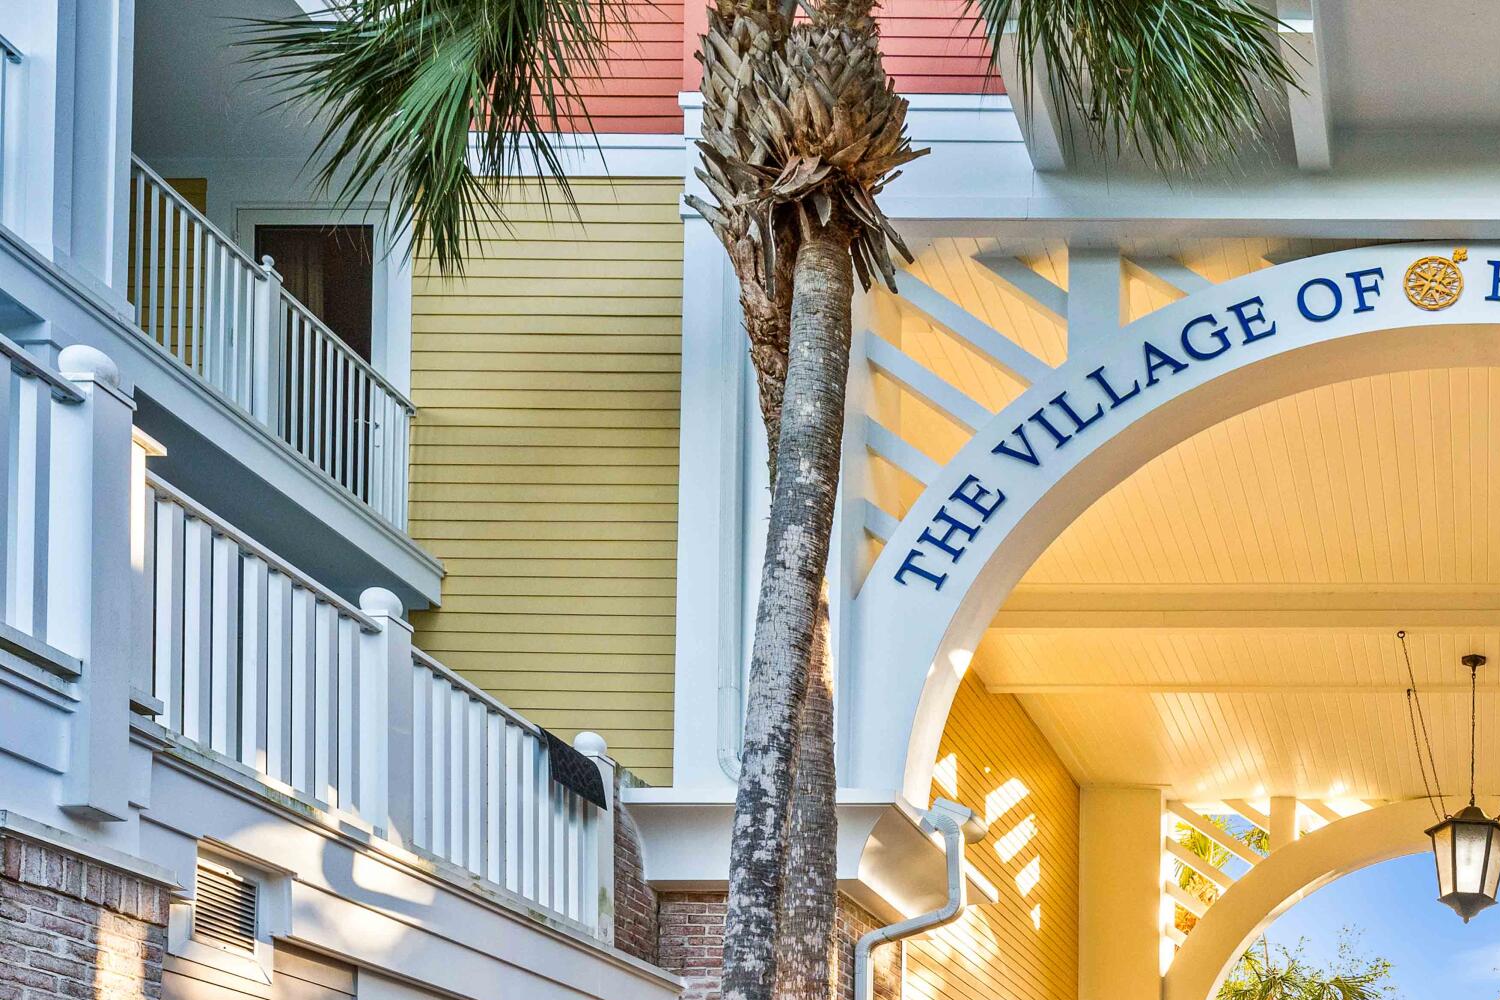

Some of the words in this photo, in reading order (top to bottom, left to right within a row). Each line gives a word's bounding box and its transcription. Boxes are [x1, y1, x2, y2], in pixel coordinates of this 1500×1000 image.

[893, 473, 1007, 592] THE
[991, 295, 1277, 467] VILLAGE
[1297, 266, 1386, 323] OF
